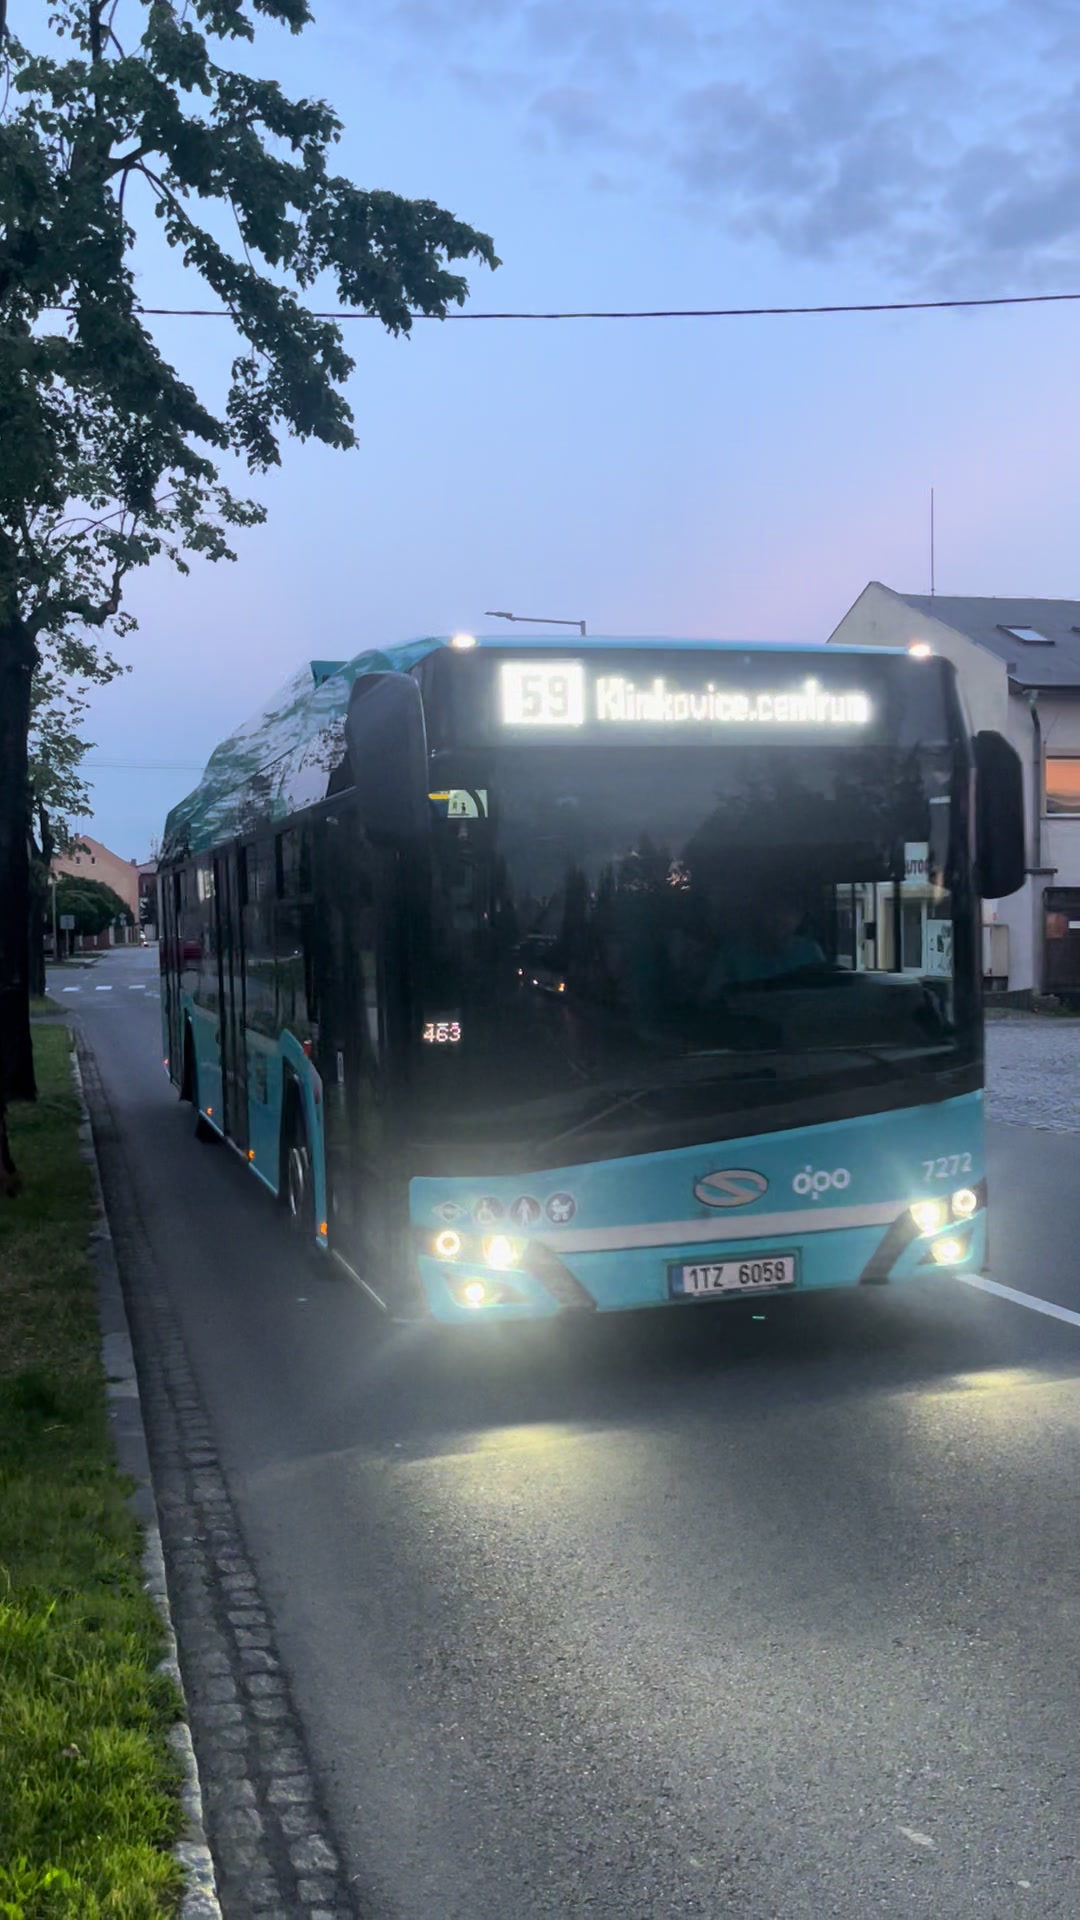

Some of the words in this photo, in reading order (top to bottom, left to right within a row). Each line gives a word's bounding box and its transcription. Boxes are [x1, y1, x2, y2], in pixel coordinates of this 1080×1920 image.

[521, 675, 569, 717] 59
[922, 1152, 972, 1181] 7272
[690, 1266, 724, 1289] 1TZ
[739, 1261, 785, 1284] 6058
